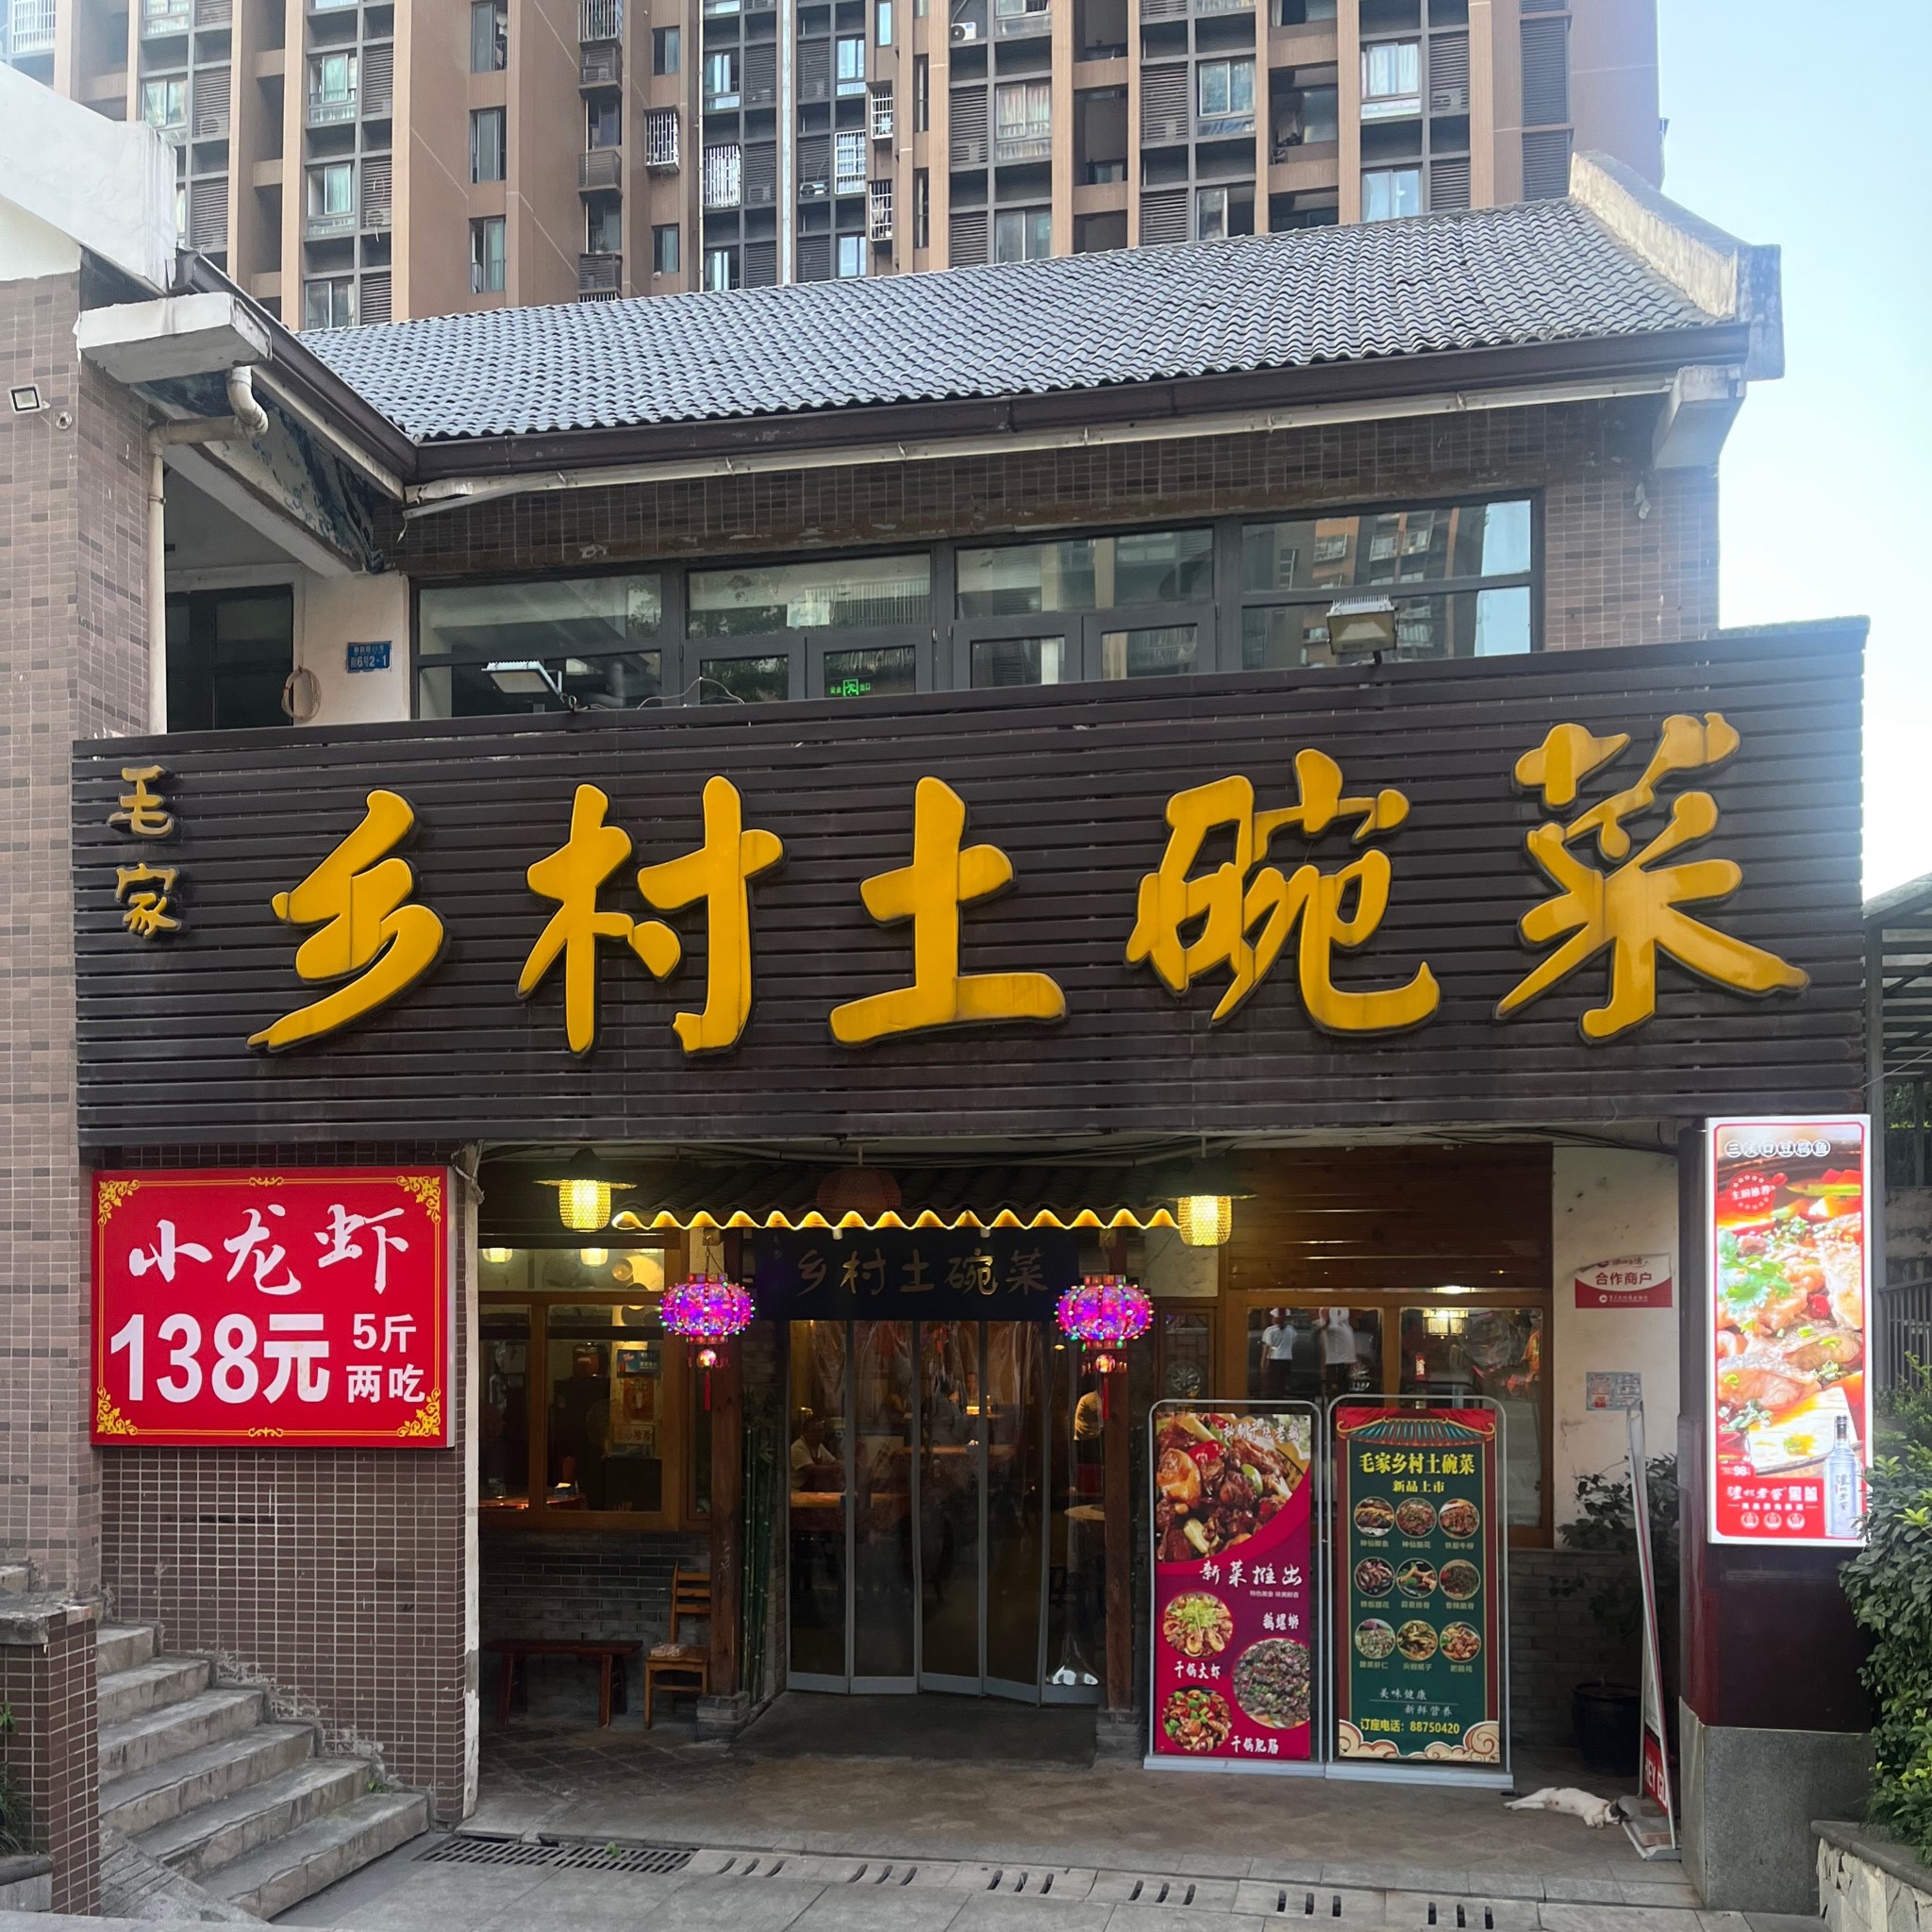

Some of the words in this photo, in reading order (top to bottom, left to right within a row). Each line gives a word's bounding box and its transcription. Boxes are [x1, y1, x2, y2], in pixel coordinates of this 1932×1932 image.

[108, 764, 181, 941] 毛家
[247, 712, 1810, 1056] 乡村土碗菜
[1725, 1140, 1831, 1158] 三溪口豆腐鱼
[1732, 1186, 1772, 1201] 主厨推荐
[128, 1204, 409, 1295] 小龙虾
[796, 1247, 1049, 1296] 乡村土碗菜
[1595, 1272, 1653, 1286] 合作商户
[353, 1313, 417, 1354] 5斤
[110, 1313, 330, 1404] 138元
[346, 1363, 425, 1404] 两吃
[1358, 1452, 1475, 1475] 毛家乡村土碗菜
[1392, 1480, 1445, 1493] 新品上市
[1199, 1559, 1303, 1589] 新菜推出
[1379, 1688, 1427, 1700] 美味健康
[1405, 1704, 1453, 1718] 新鲜营养
